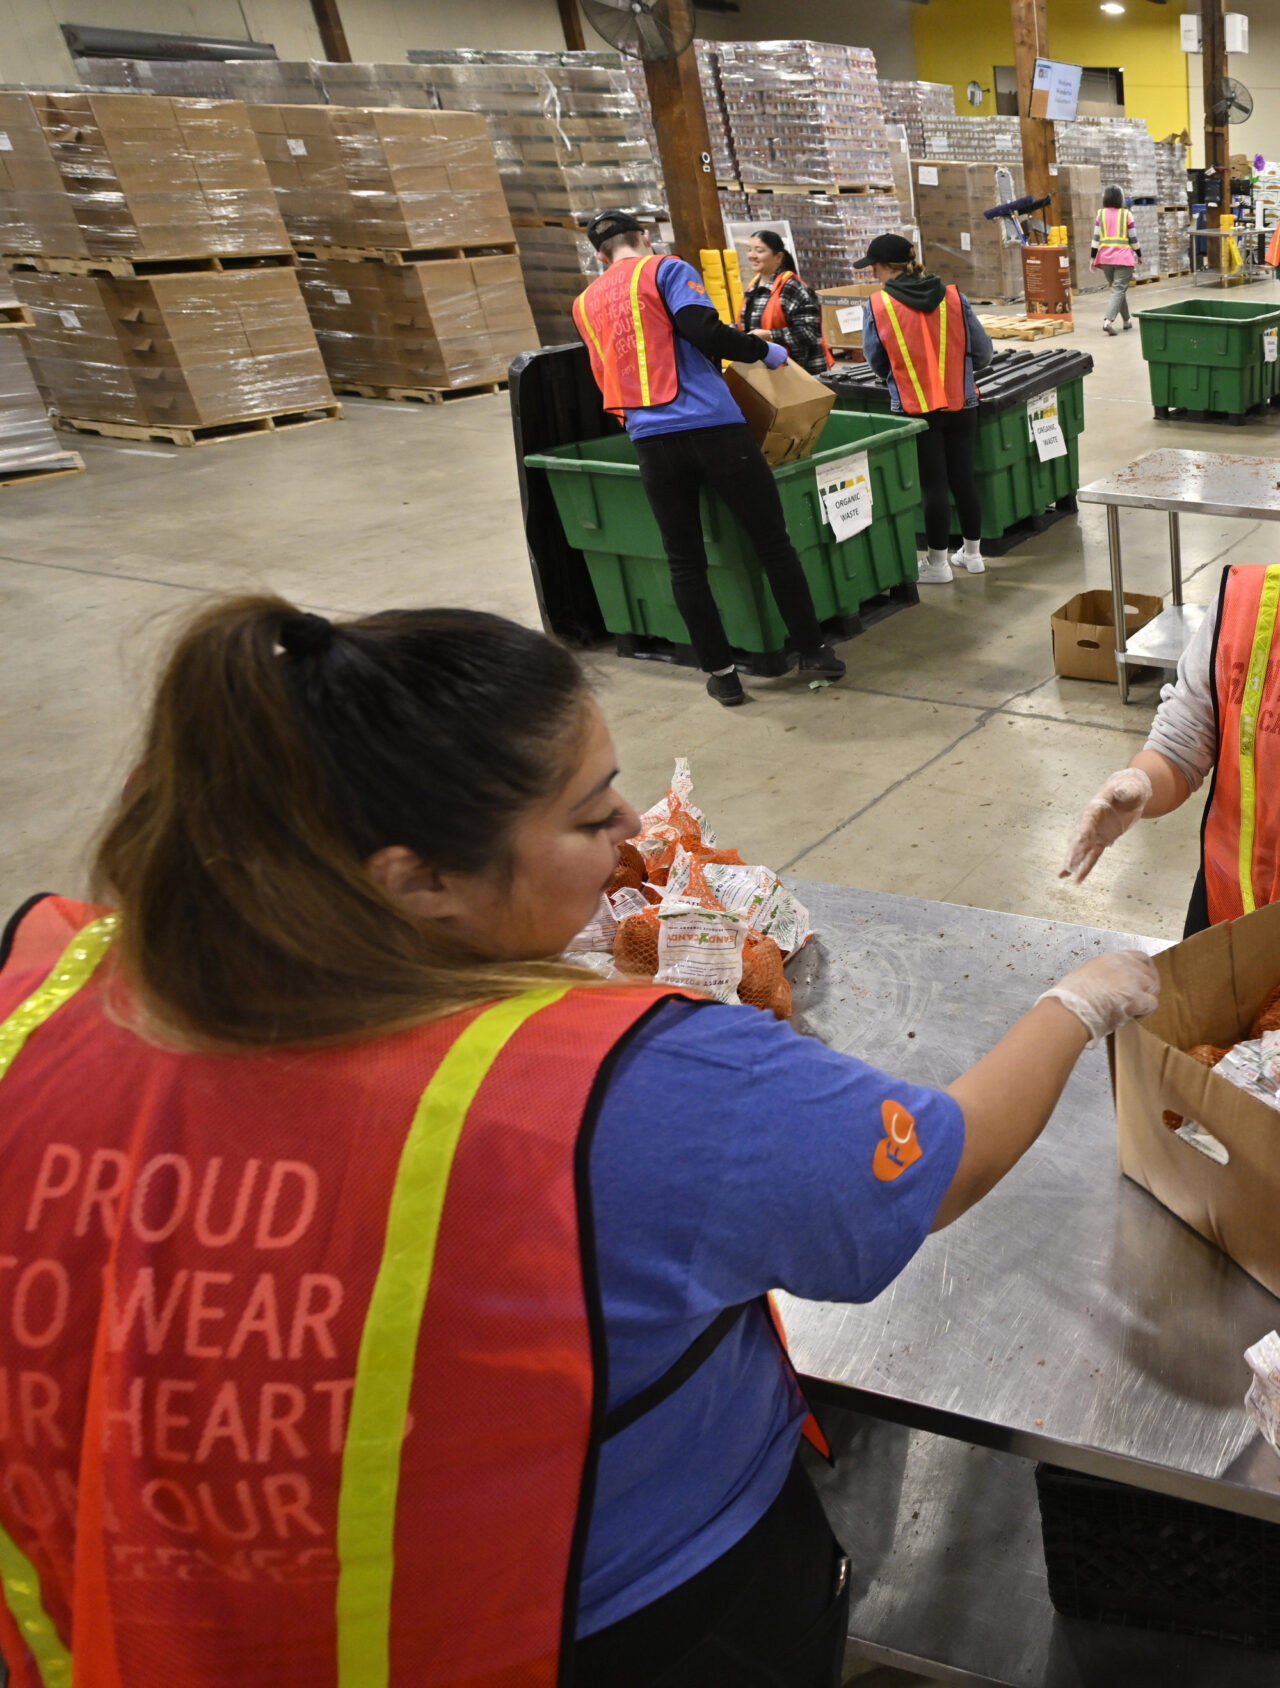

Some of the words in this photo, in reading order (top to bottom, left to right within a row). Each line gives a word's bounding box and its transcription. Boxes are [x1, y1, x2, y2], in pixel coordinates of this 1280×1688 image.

[1037, 424, 1057, 435] ORGANIC
[1043, 436, 1059, 446] WASTE
[835, 493, 861, 509] ORGANIC
[840, 508, 860, 523] WASTE
[25, 1143, 320, 1250] PROUD
[103, 1266, 345, 1361] WEAR
[103, 1376, 414, 1463] HEART
[142, 1472, 326, 1541] OUR
